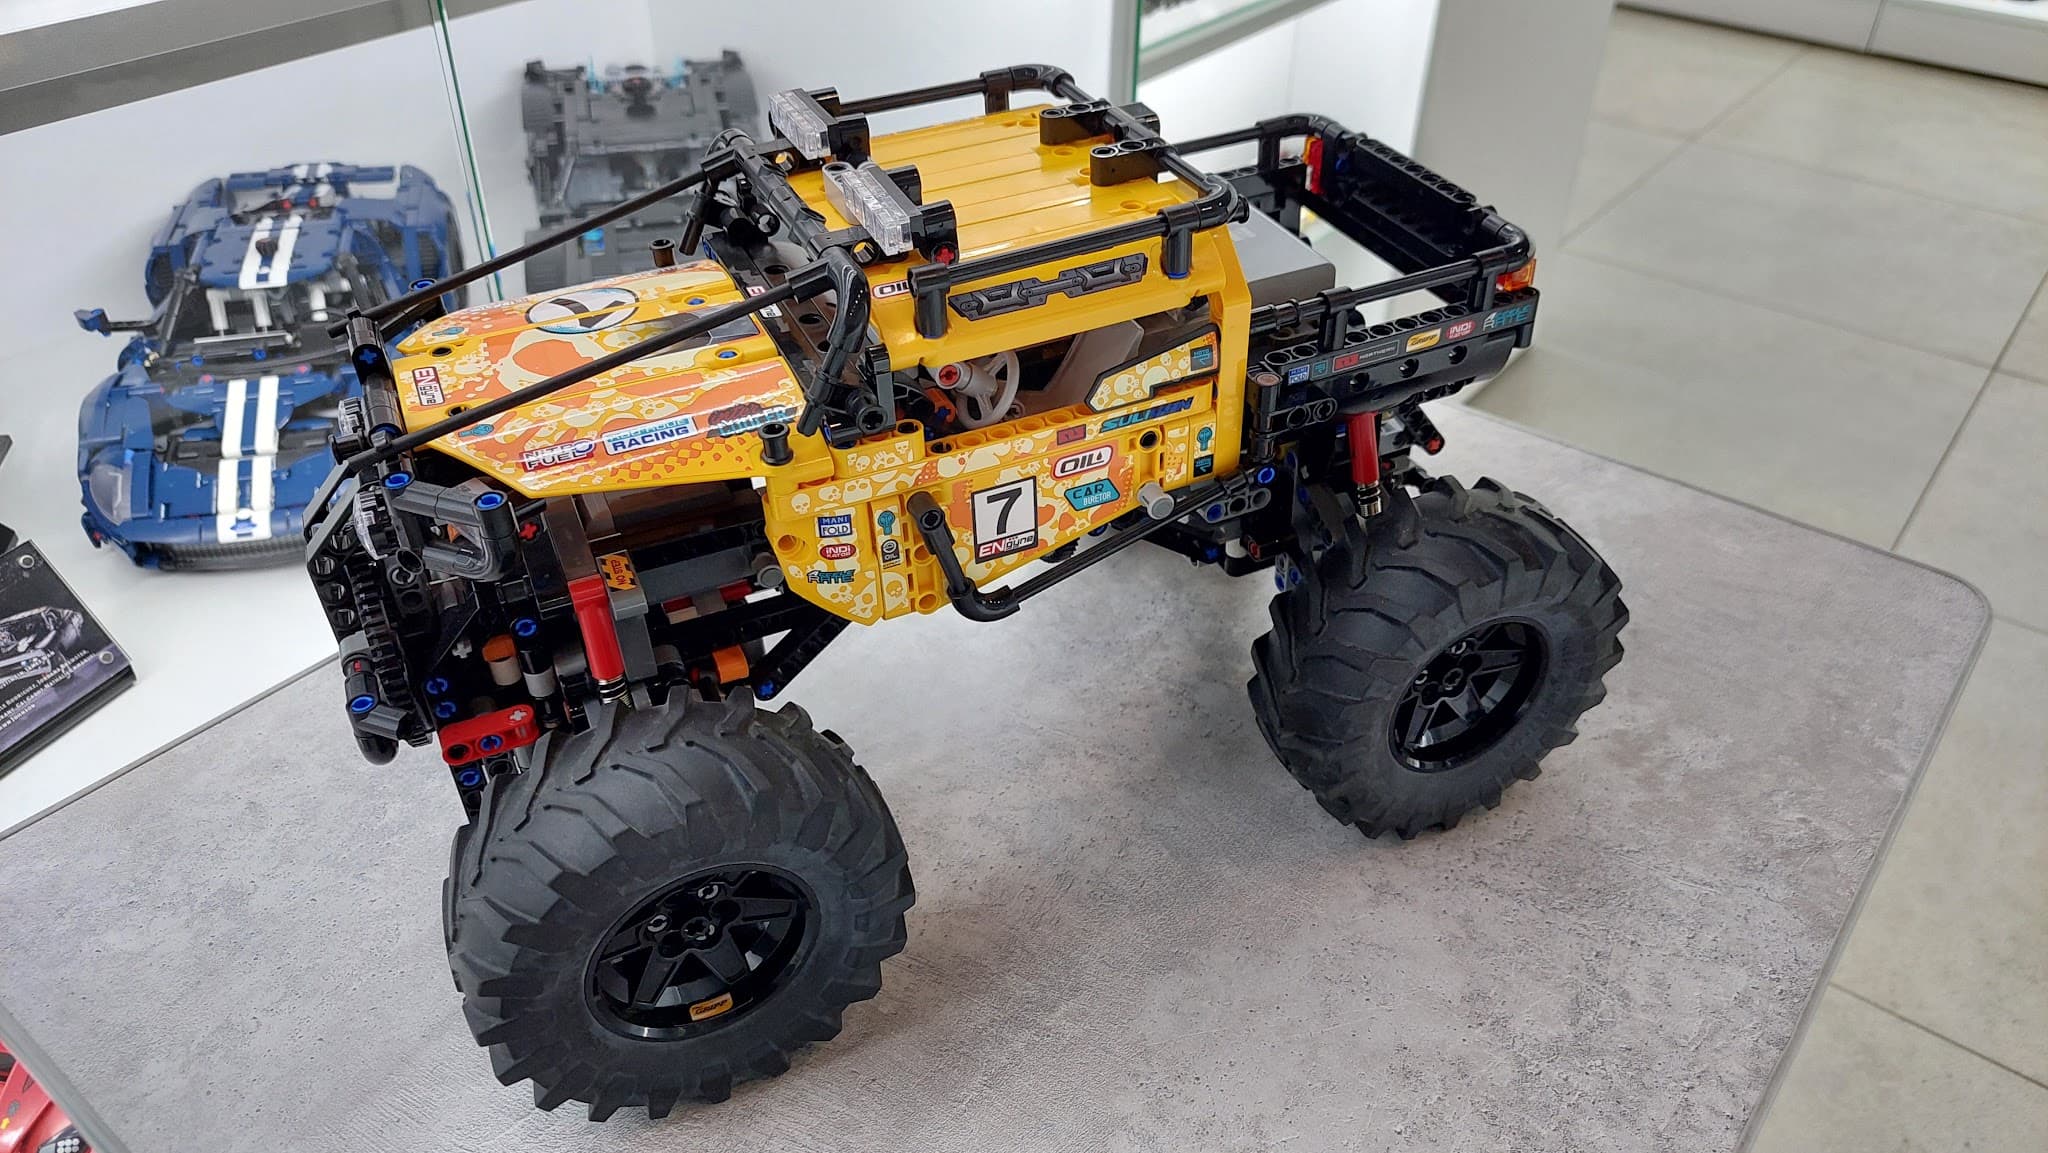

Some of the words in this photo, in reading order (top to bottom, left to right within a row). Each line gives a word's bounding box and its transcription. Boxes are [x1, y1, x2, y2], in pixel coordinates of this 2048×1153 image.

[612, 427, 690, 452] RACING
[528, 451, 581, 469] FUEL
[1060, 453, 1105, 474] OIL
[1073, 483, 1105, 499] CAR
[822, 516, 848, 525] MANI
[986, 487, 1022, 536] 7
[822, 525, 849, 535] FOLD
